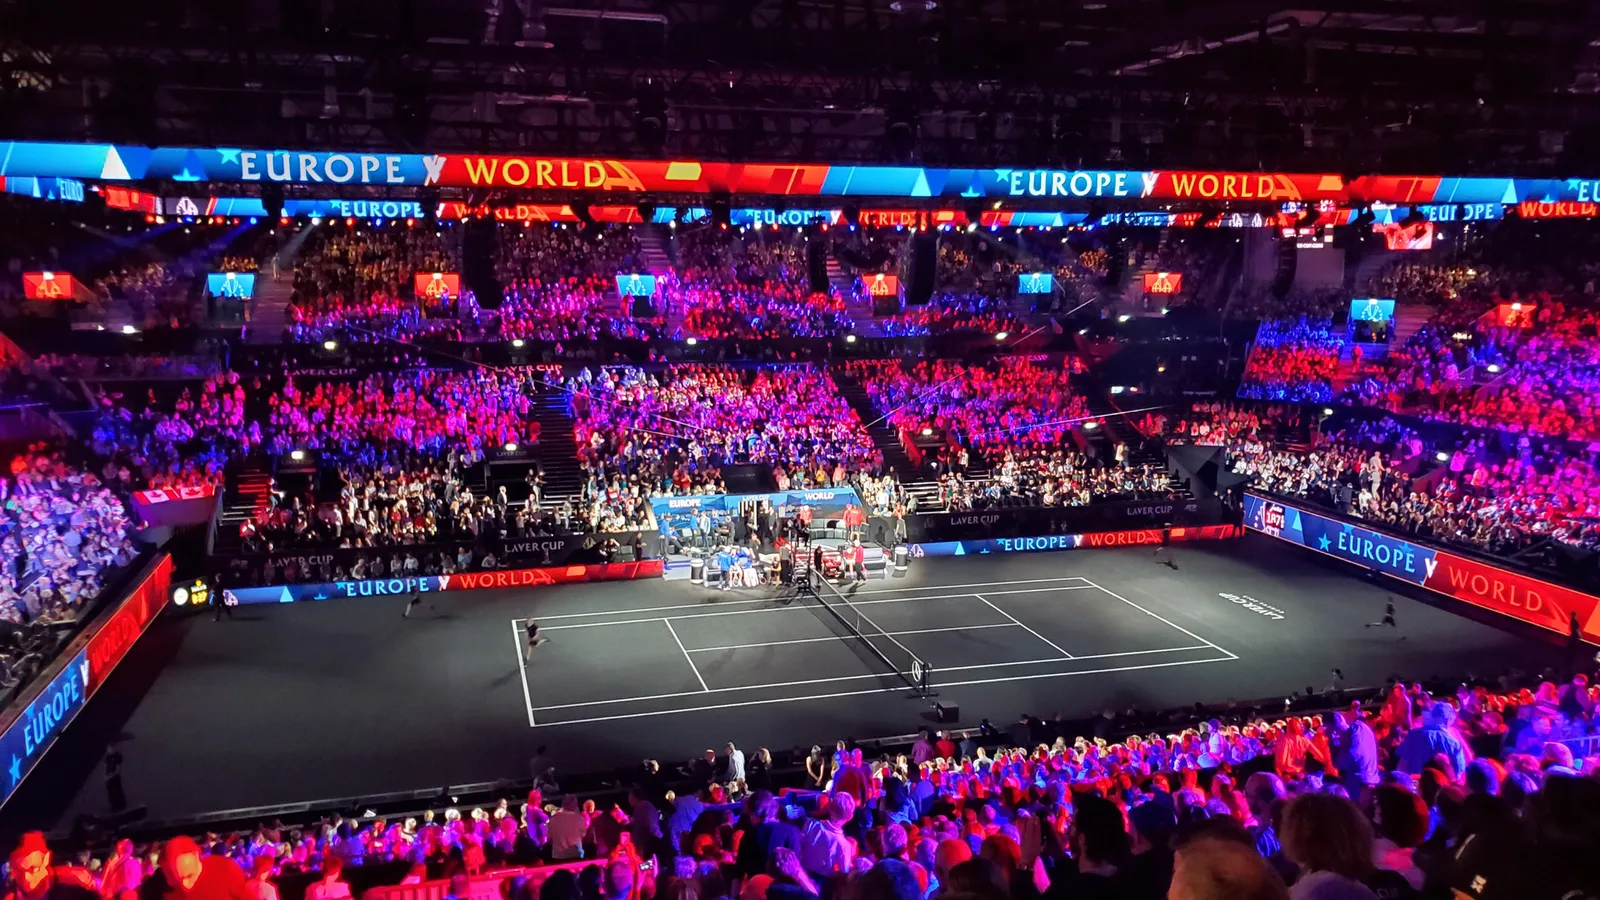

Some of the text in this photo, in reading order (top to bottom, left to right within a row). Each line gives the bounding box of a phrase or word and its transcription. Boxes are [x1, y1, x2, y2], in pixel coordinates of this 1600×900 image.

[240, 152, 405, 184] EUROPE
[463, 157, 606, 188] WORLD
[1009, 171, 1128, 197] EUROPE
[1171, 174, 1273, 198] WORLD
[341, 201, 424, 218] EUROPE
[453, 202, 529, 219] WLD
[1521, 201, 1595, 217] WORLD
[754, 210, 825, 226] EUROP
[329, 368, 357, 376] CUP
[536, 364, 562, 372] CUP
[669, 499, 702, 508] EUROPE
[804, 492, 835, 501] WORLD
[1127, 505, 1173, 515] LAVER CUP
[950, 514, 1000, 526] LAVER CUP
[505, 540, 565, 553] LAVER CUP
[1005, 535, 1067, 551] EUROPE
[1090, 531, 1146, 546] WORLD
[307, 554, 334, 566] CUP
[1337, 530, 1416, 574] EUROPE
[1448, 564, 1544, 613] WORLD
[346, 577, 430, 597] EUROPE
[460, 570, 535, 588] WORLD
[24, 674, 79, 757] EUROPE
